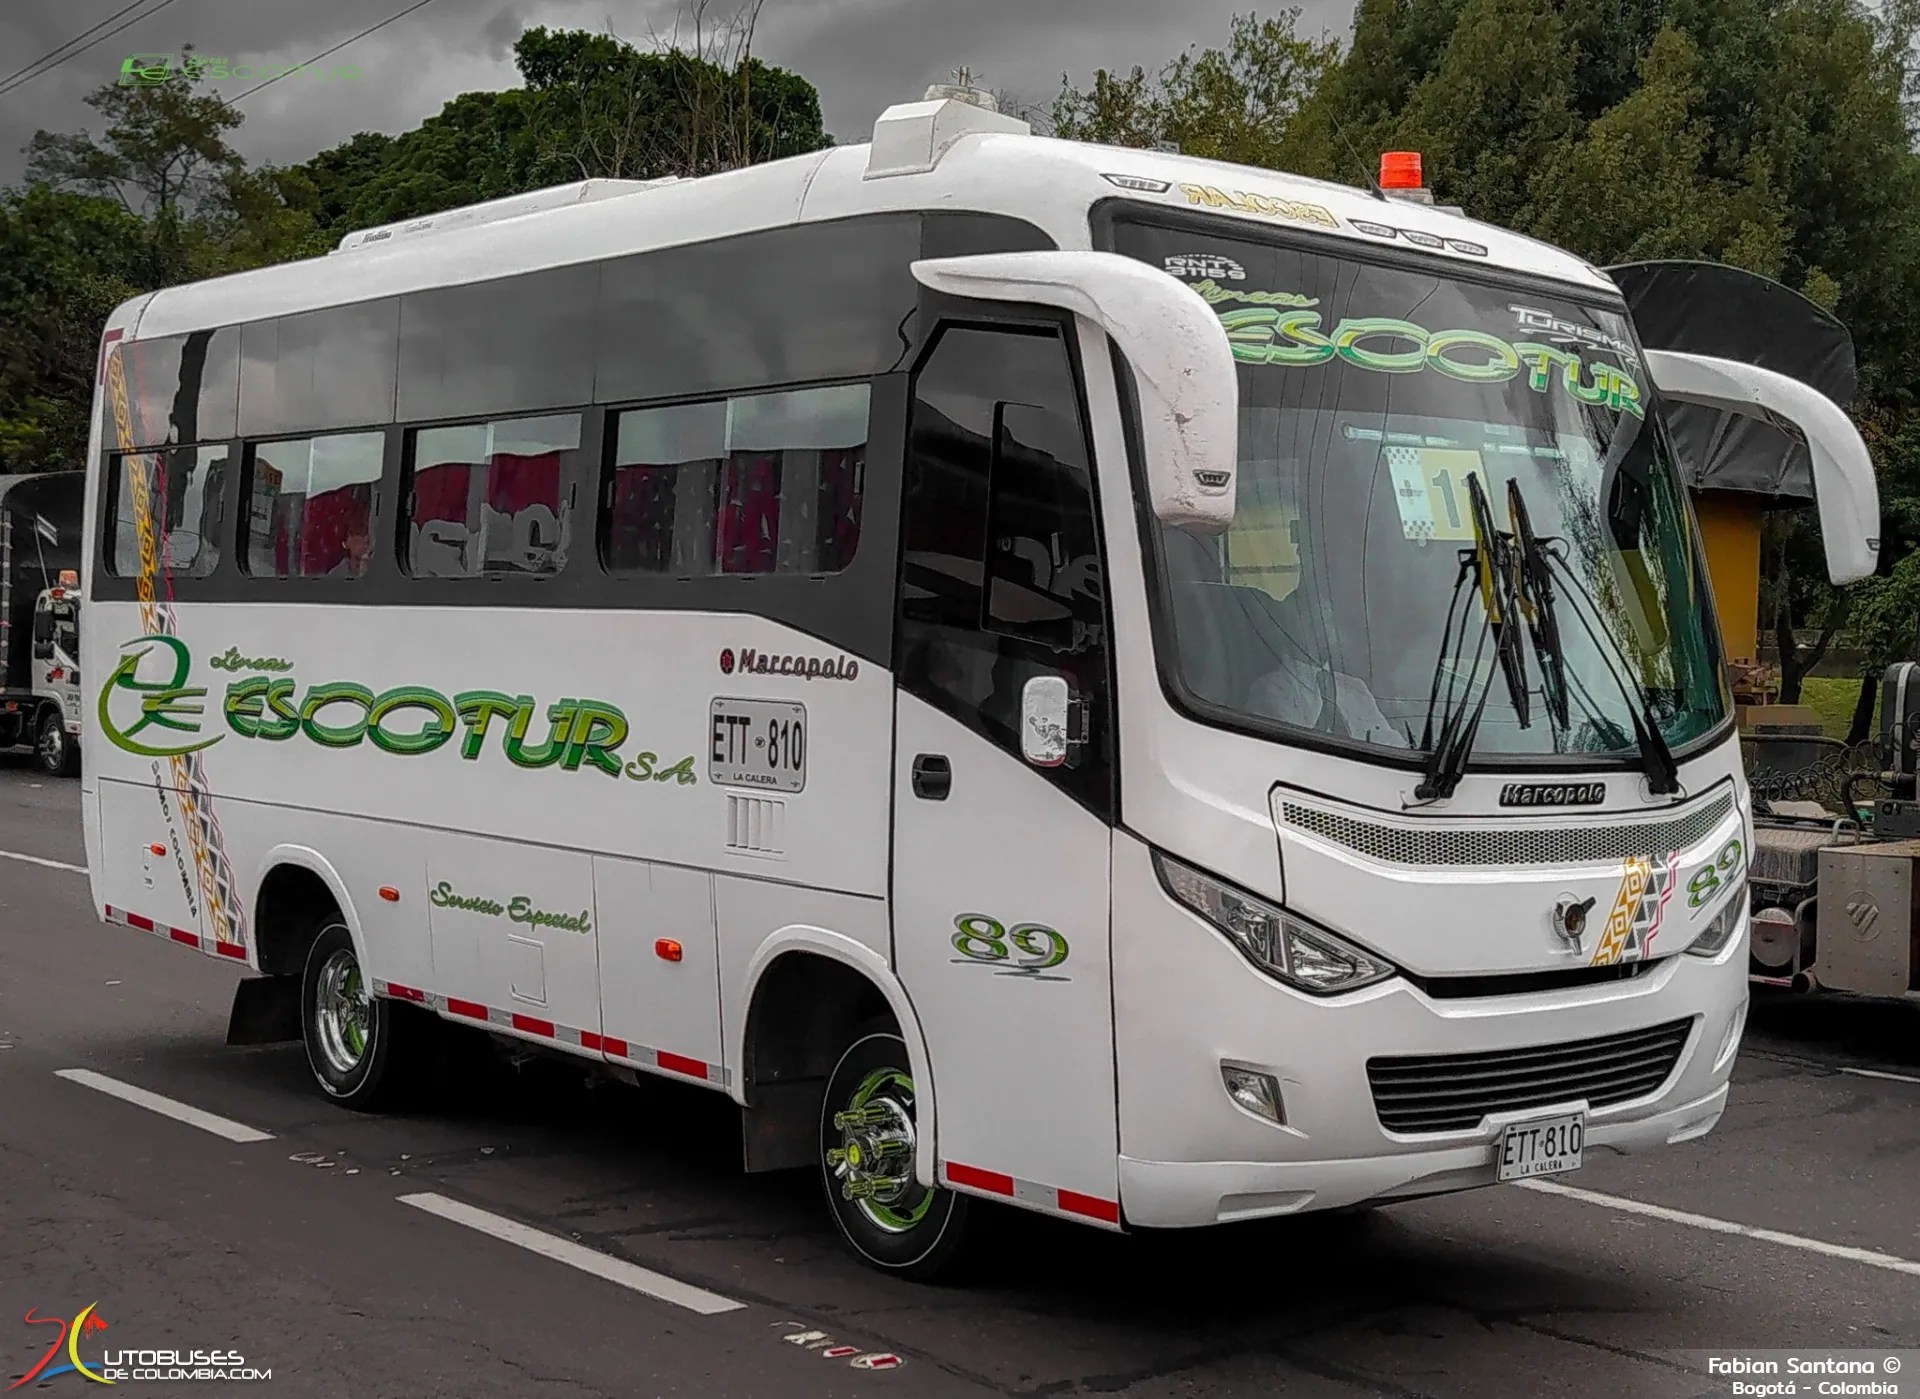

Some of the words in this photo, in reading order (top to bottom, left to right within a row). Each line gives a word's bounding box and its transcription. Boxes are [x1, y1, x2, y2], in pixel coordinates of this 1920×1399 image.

[1508, 303, 1638, 358] TURISMO
[1218, 307, 1645, 420] ESCOTUR
[738, 648, 859, 682] Marcopolo
[223, 676, 630, 778] ESCOTUR
[713, 714, 751, 765] ETT
[767, 718, 803, 771] 810
[733, 773, 744, 782] LA
[745, 773, 778, 785] CALERA
[1502, 783, 1605, 805] Marcopolo
[169, 827, 198, 919] COLOMBIA
[1687, 838, 1742, 909] 89
[507, 895, 592, 934] Especial
[950, 912, 1070, 969] 89
[1503, 1128, 1541, 1166] ETT
[1544, 1123, 1582, 1157] 810
[1520, 1164, 1530, 1175] LA
[1534, 1159, 1563, 1173] CALERA
